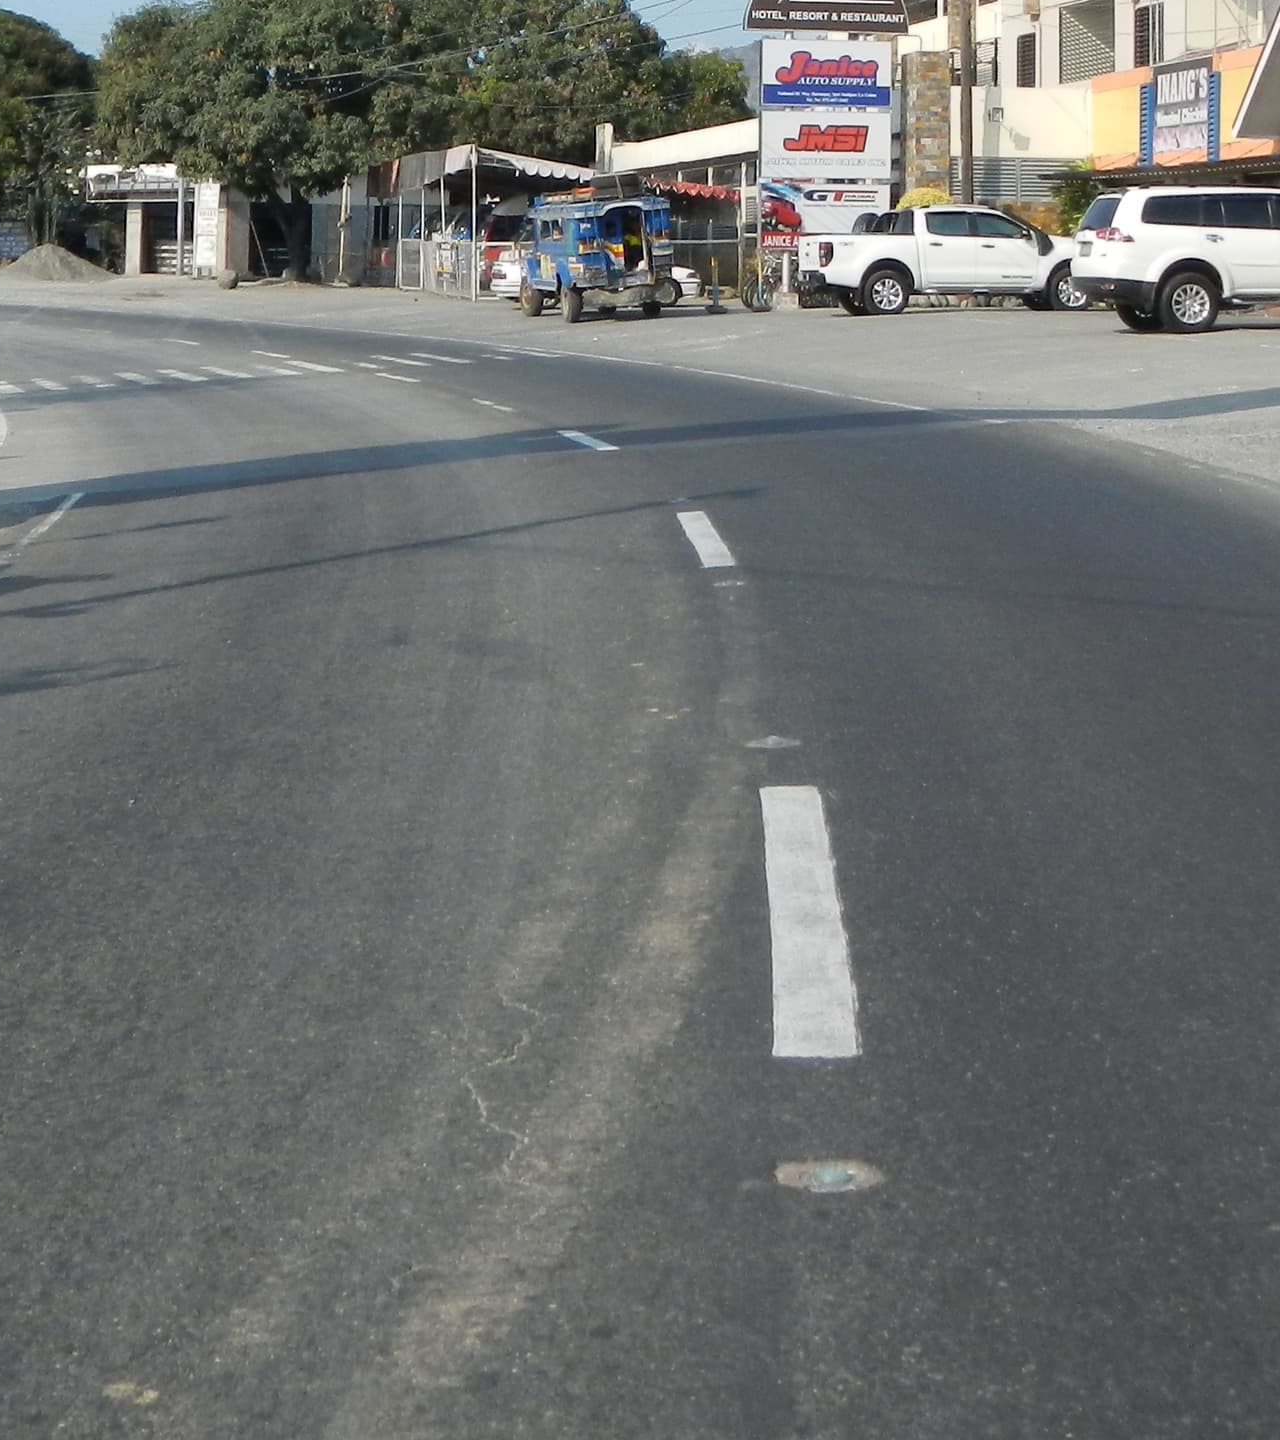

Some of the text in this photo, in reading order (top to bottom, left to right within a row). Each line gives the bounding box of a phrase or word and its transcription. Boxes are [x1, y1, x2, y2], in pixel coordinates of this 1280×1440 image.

[752, 10, 905, 23] HOTEL, RESORT & RESTAURANT
[775, 51, 878, 84] Janice
[797, 76, 875, 86] AUTO SUPPLY
[1157, 67, 1208, 105] INANG'S
[783, 124, 869, 152] JMSI
[803, 189, 845, 201] GT
[762, 235, 791, 247] JANICE
